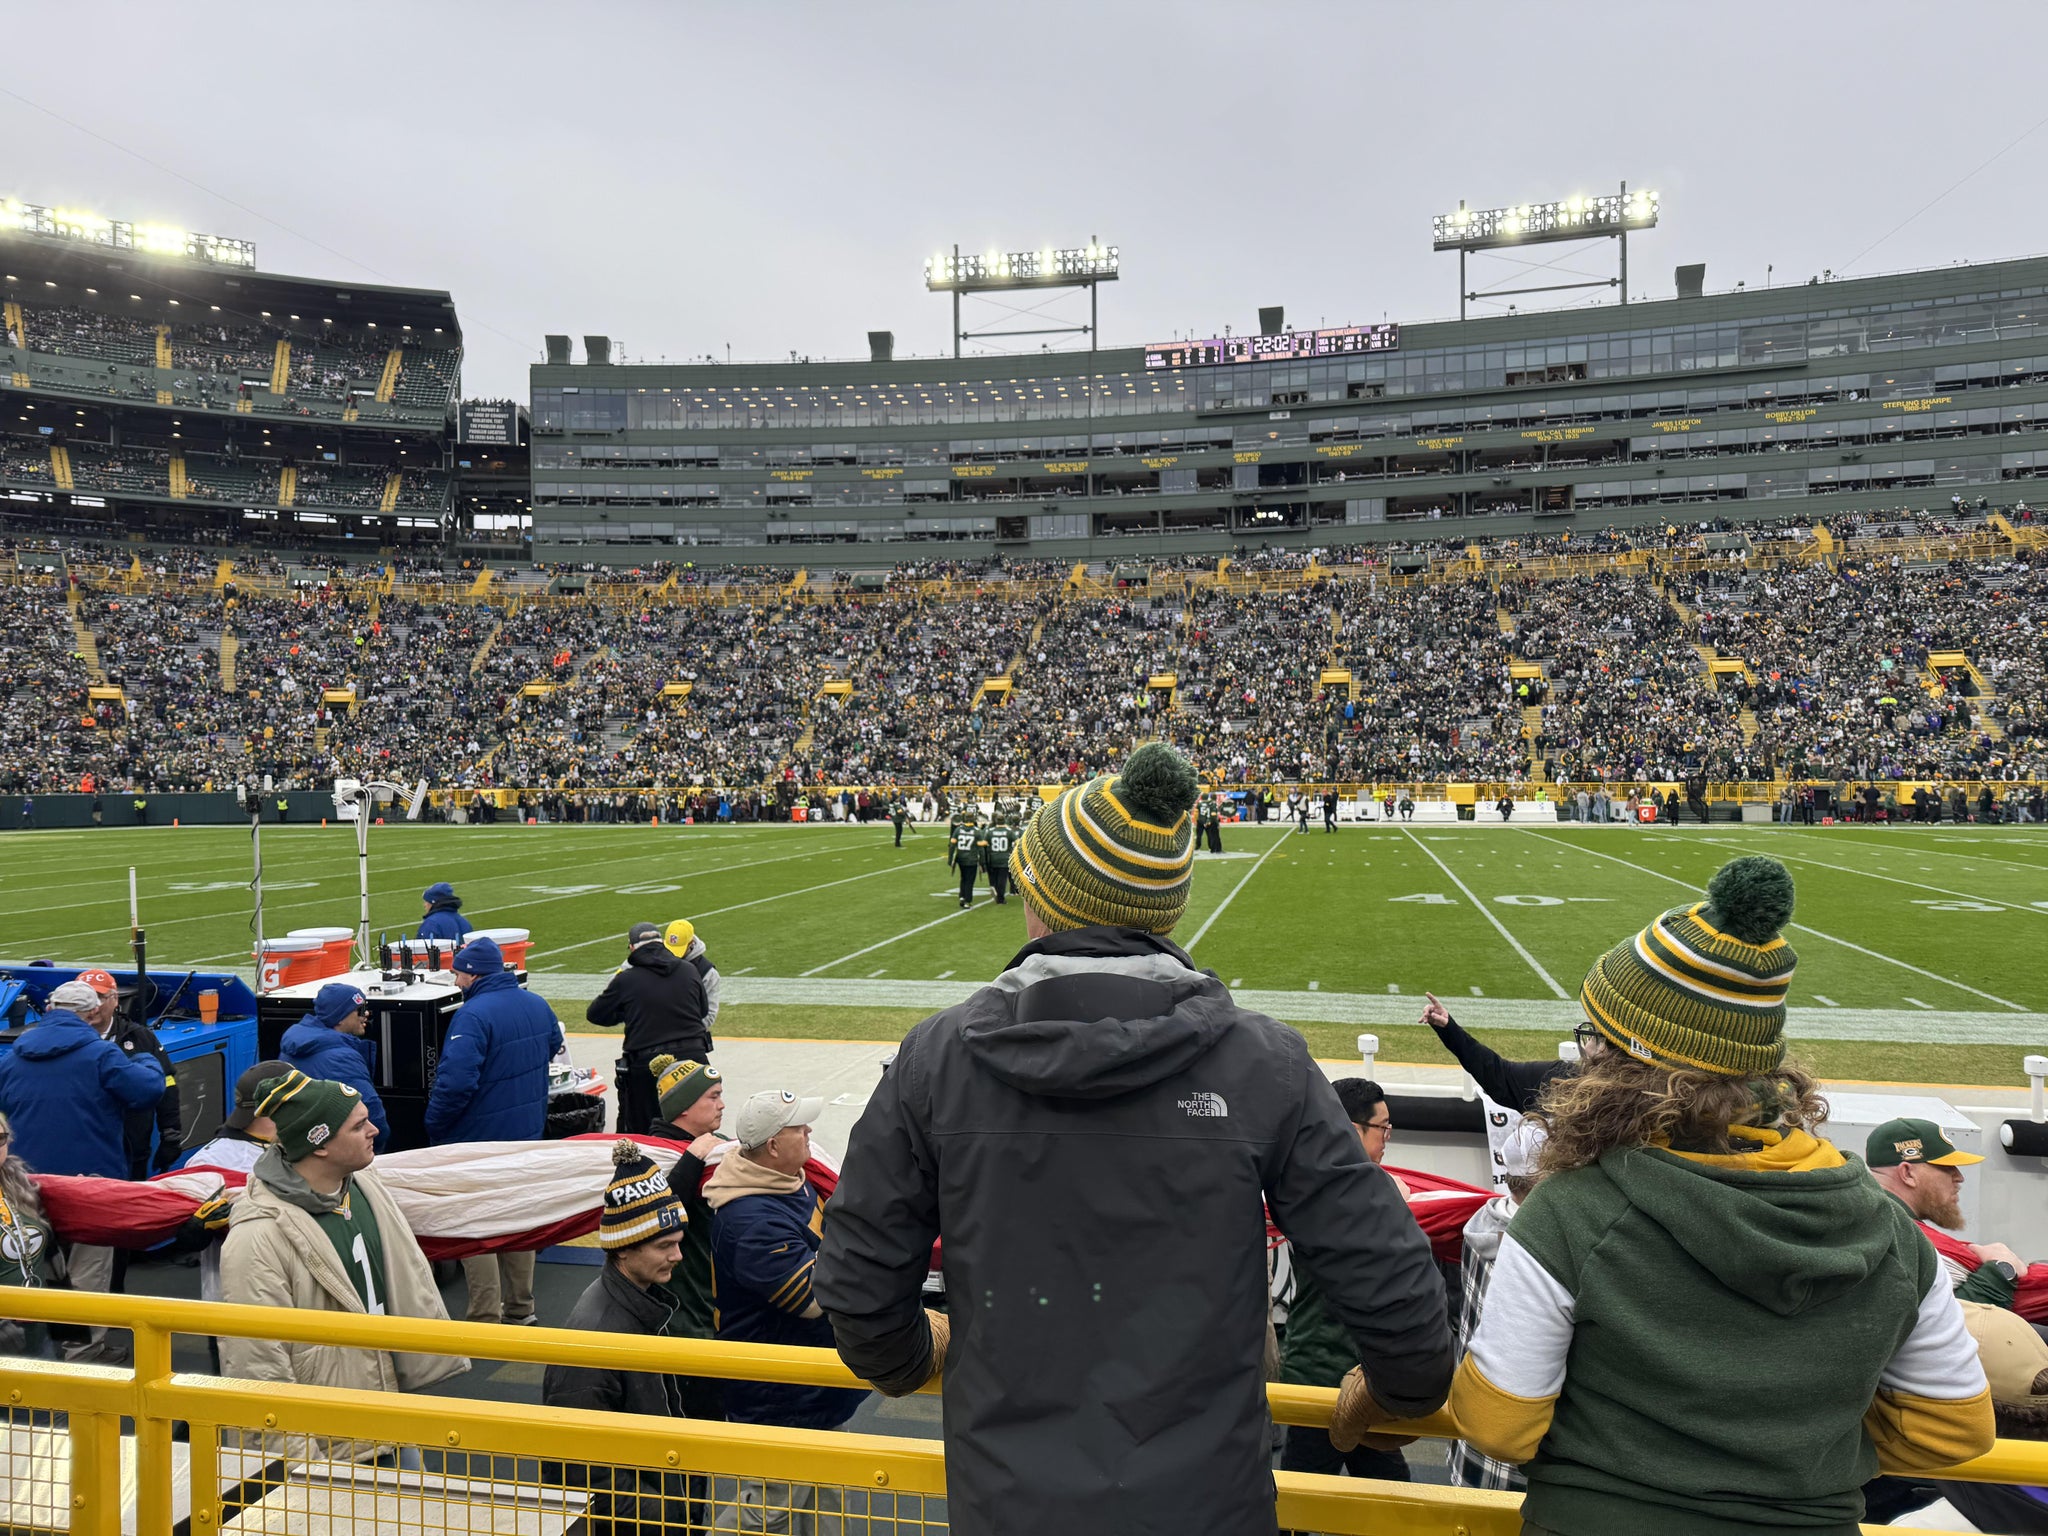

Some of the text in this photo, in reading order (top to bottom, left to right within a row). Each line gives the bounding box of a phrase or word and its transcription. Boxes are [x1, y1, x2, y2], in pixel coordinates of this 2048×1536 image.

[1229, 344, 1237, 356] 0
[1254, 336, 1290, 352] 22:02
[1304, 339, 1311, 350] 0
[1882, 400, 1919, 408] STERLING
[958, 835, 975, 851] 27
[991, 837, 1008, 852] 80
[262, 962, 280, 989] G
[1177, 1100, 1211, 1108] NORTH
[1187, 1109, 1211, 1117] FACE
[1893, 1139, 1923, 1153] PACKERS
[657, 1207, 681, 1228] GB
